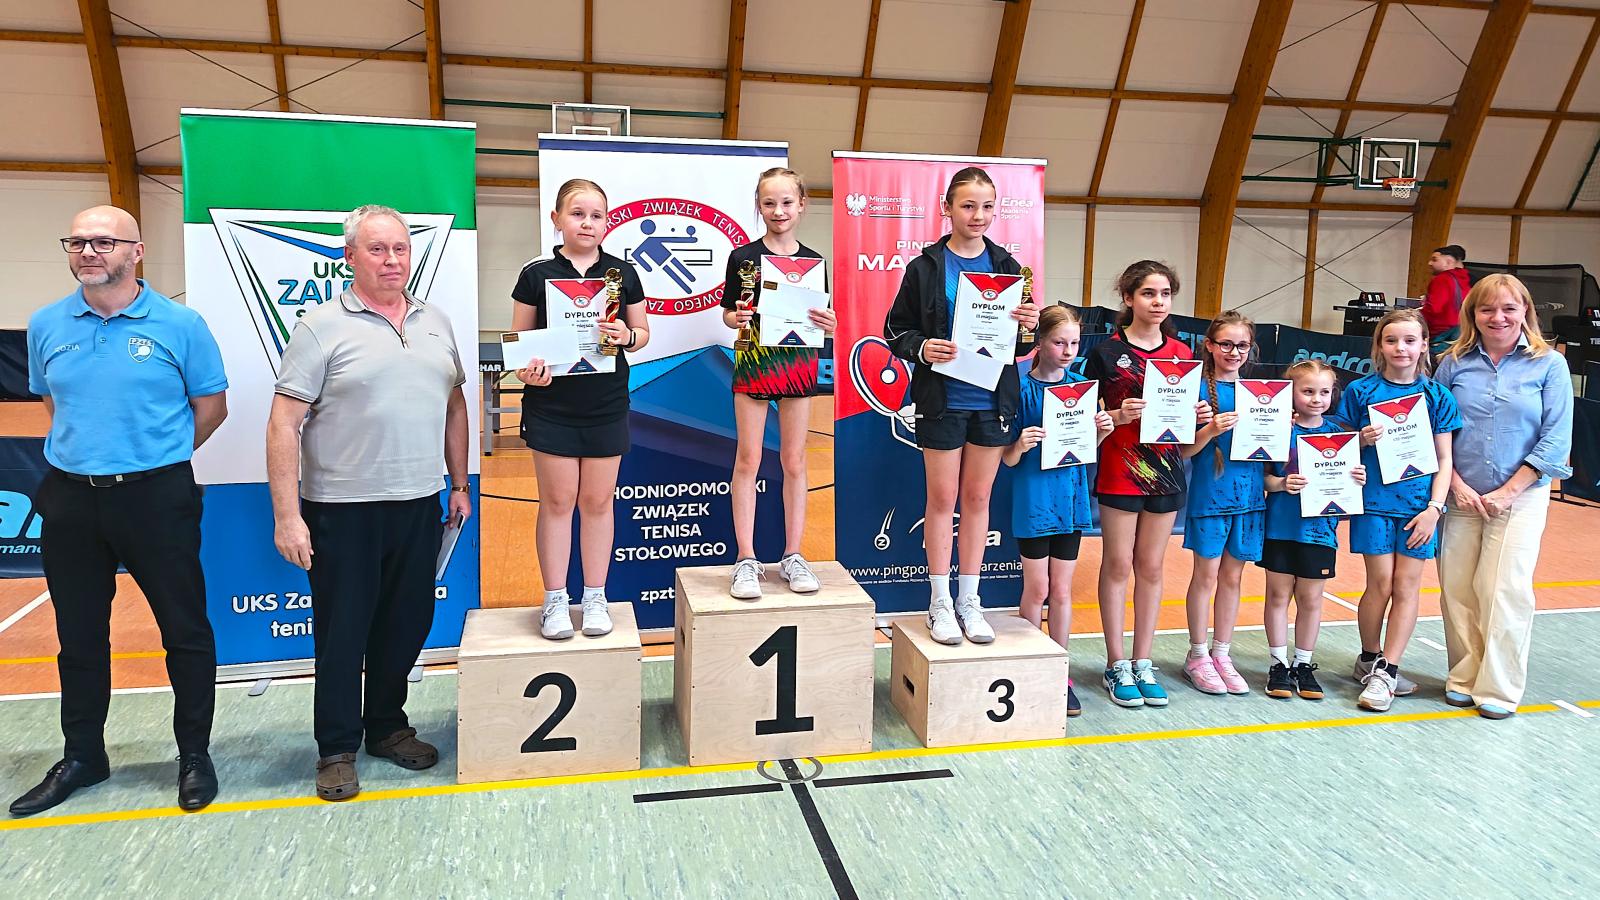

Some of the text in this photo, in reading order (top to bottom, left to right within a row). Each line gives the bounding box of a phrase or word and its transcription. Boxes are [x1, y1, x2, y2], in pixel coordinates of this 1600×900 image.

[1001, 197, 1034, 207] Enea
[643, 202, 703, 220] ZWIĄZEK
[712, 213, 755, 247] TENIS
[314, 262, 355, 279] UKS
[565, 311, 600, 319] DYPLOM
[972, 303, 1005, 311] DYPLOM
[1293, 348, 1374, 376] andro
[1056, 409, 1084, 419] DYPLOM
[1388, 423, 1417, 435] DYPLOM
[632, 502, 709, 521] ZWIĄZEK
[641, 523, 702, 540] TENISA
[615, 541, 726, 562] STOŁOWEGO
[232, 592, 313, 613] UKS Za
[641, 587, 676, 604] zpzt
[270, 617, 313, 638] teni
[748, 625, 815, 736] 1
[986, 678, 1015, 723] 3
[520, 671, 577, 755] 2
